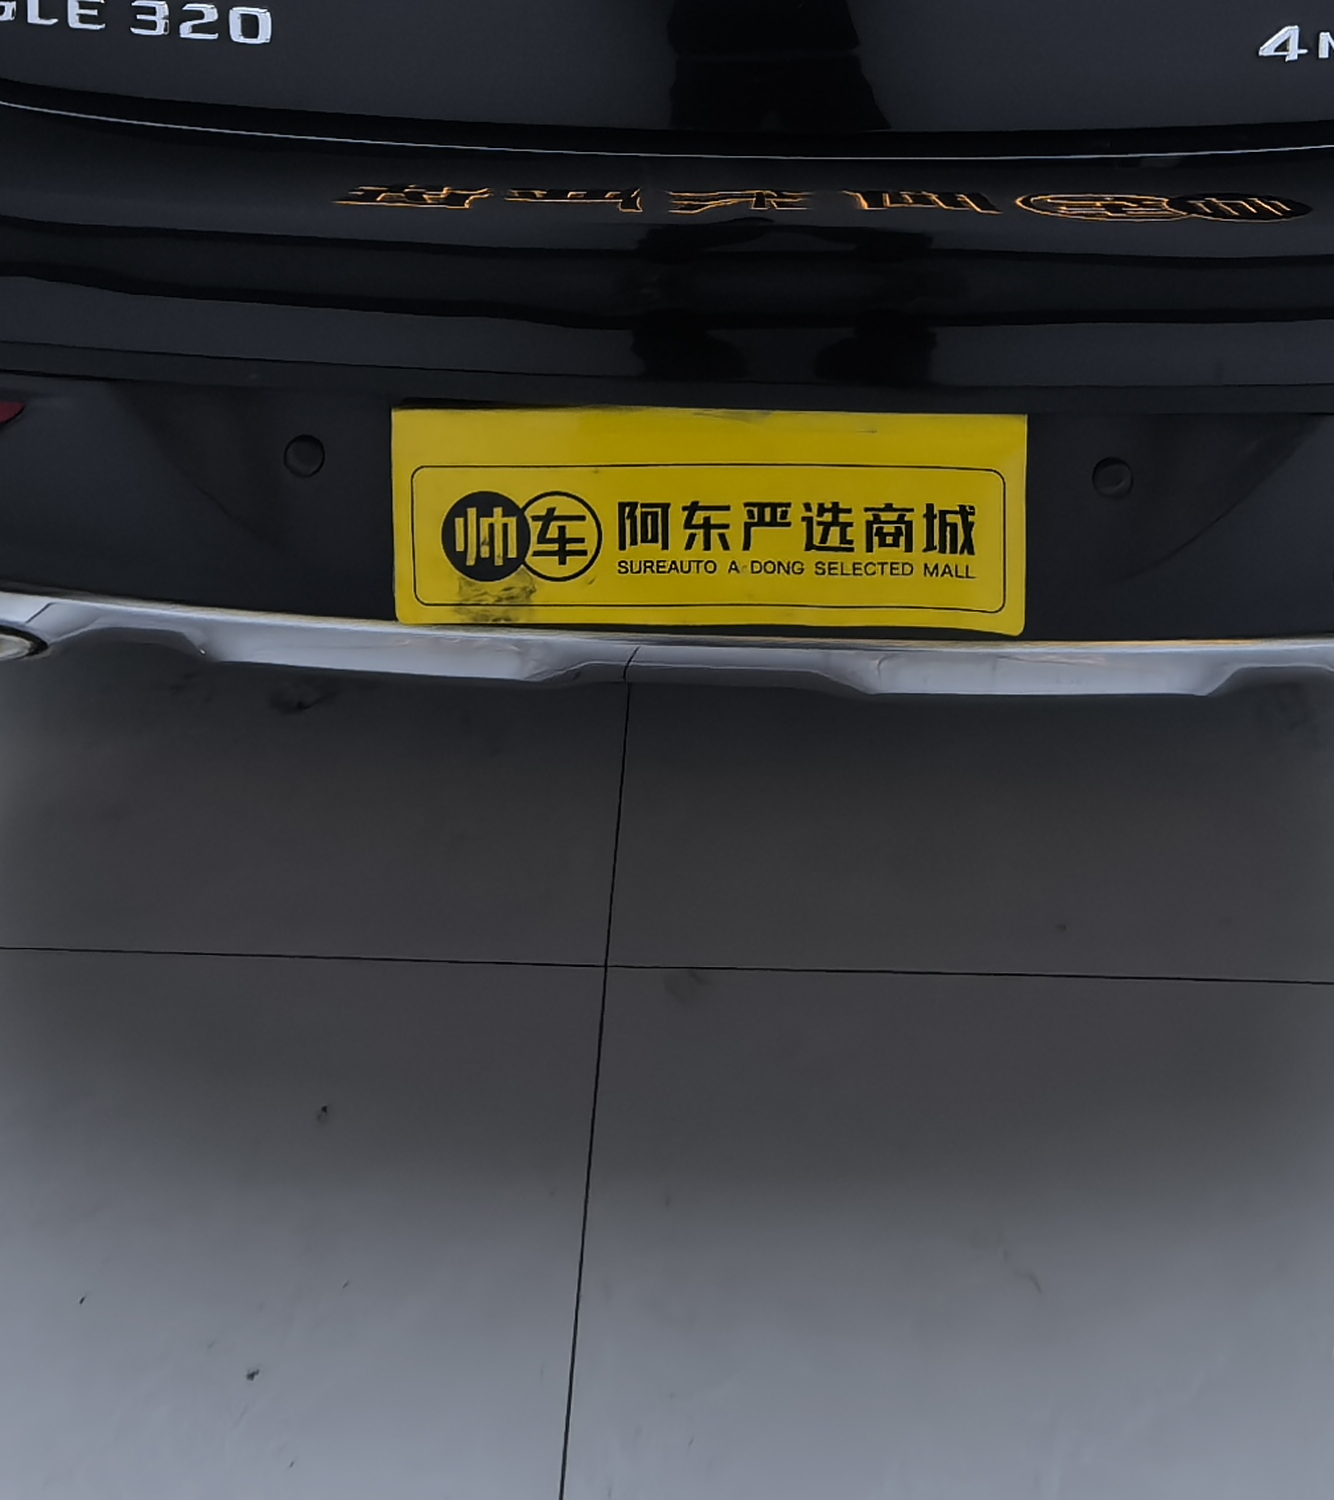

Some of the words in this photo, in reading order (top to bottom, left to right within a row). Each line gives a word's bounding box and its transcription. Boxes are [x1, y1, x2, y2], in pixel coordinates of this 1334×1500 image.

[129, 0, 273, 45] 320
[451, 503, 593, 569] 帅车
[617, 500, 976, 556] 阿东严选商城
[617, 559, 718, 575] SUREAUTO
[814, 560, 914, 577] SELECTED
[923, 562, 977, 579] MALL
